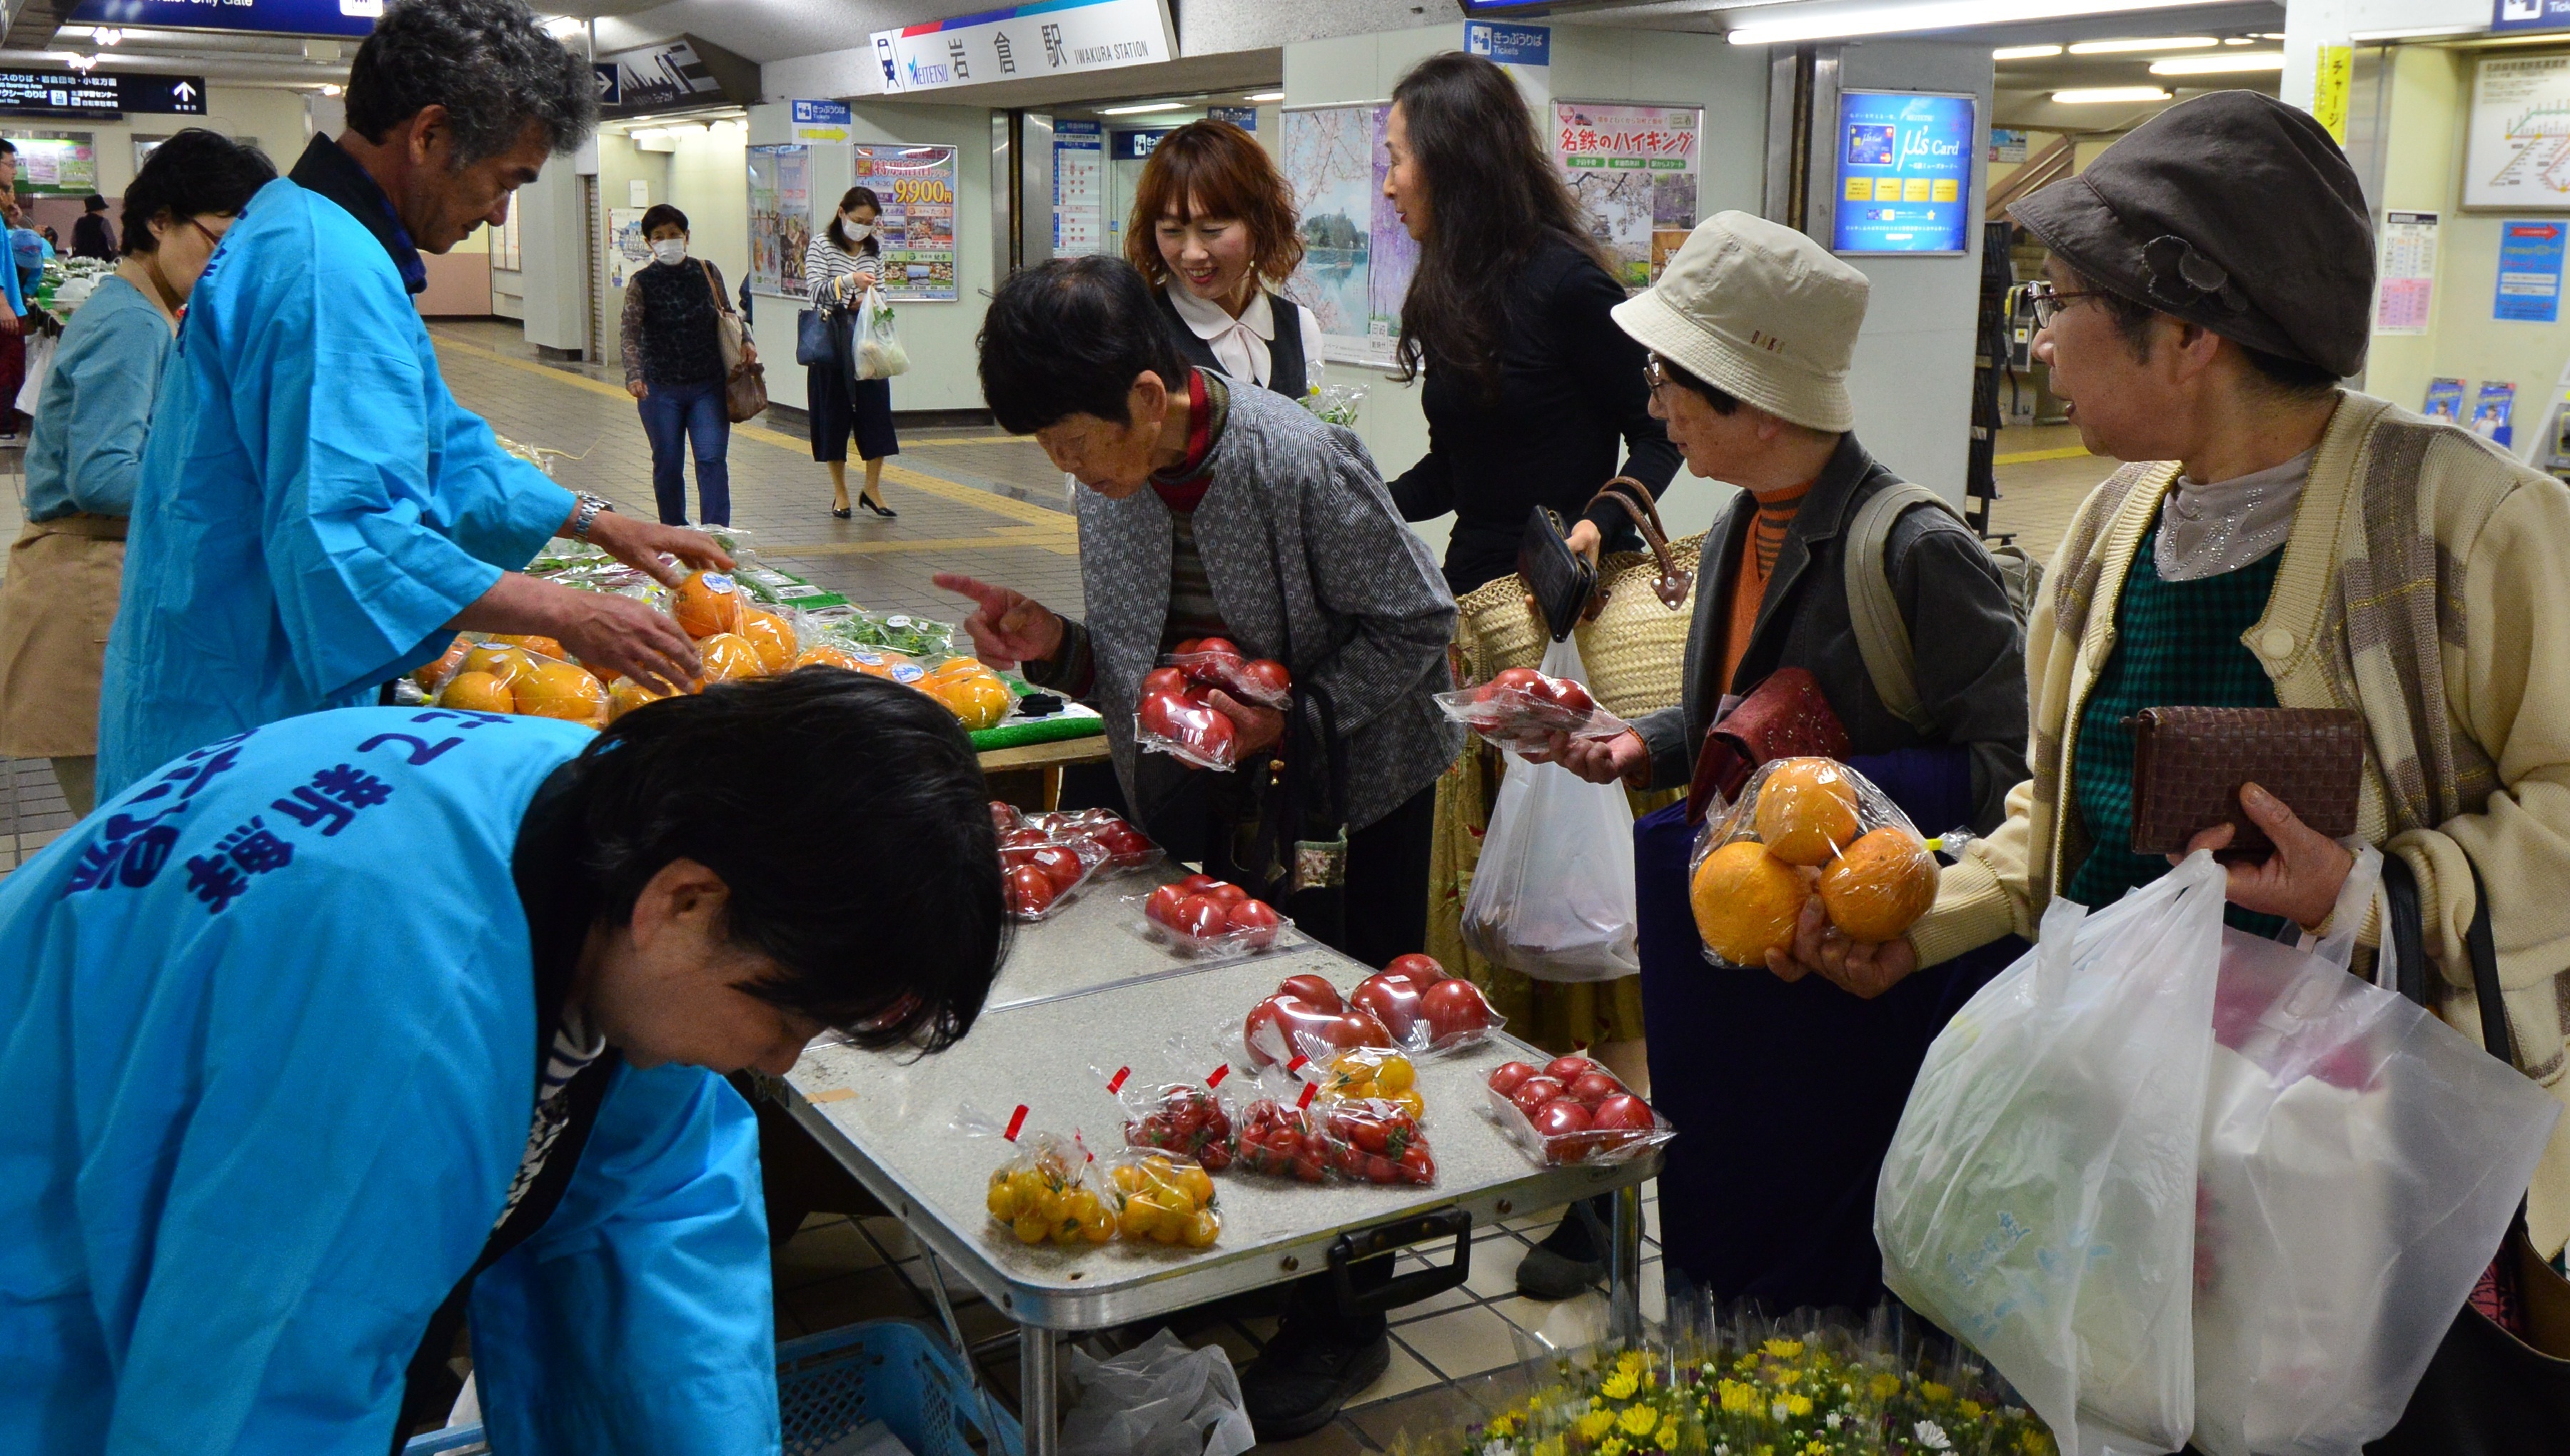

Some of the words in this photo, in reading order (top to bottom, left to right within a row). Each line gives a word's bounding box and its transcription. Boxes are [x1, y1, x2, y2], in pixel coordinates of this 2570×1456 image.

[1493, 31, 1543, 46] きっぷうりば
[1493, 45, 1518, 55] Tickets
[948, 24, 1067, 79] 岩倉駅
[1074, 46, 1112, 64] IWAKURA
[1114, 41, 1149, 59] STATION
[908, 54, 948, 85] MEITETSU
[812, 105, 845, 114] きっぷうりば
[1561, 128, 1693, 153] 名鉄のハイキング
[1932, 139, 1960, 156] Card
[895, 178, 952, 203] 9,900円
[1750, 329, 1785, 355] DAKS
